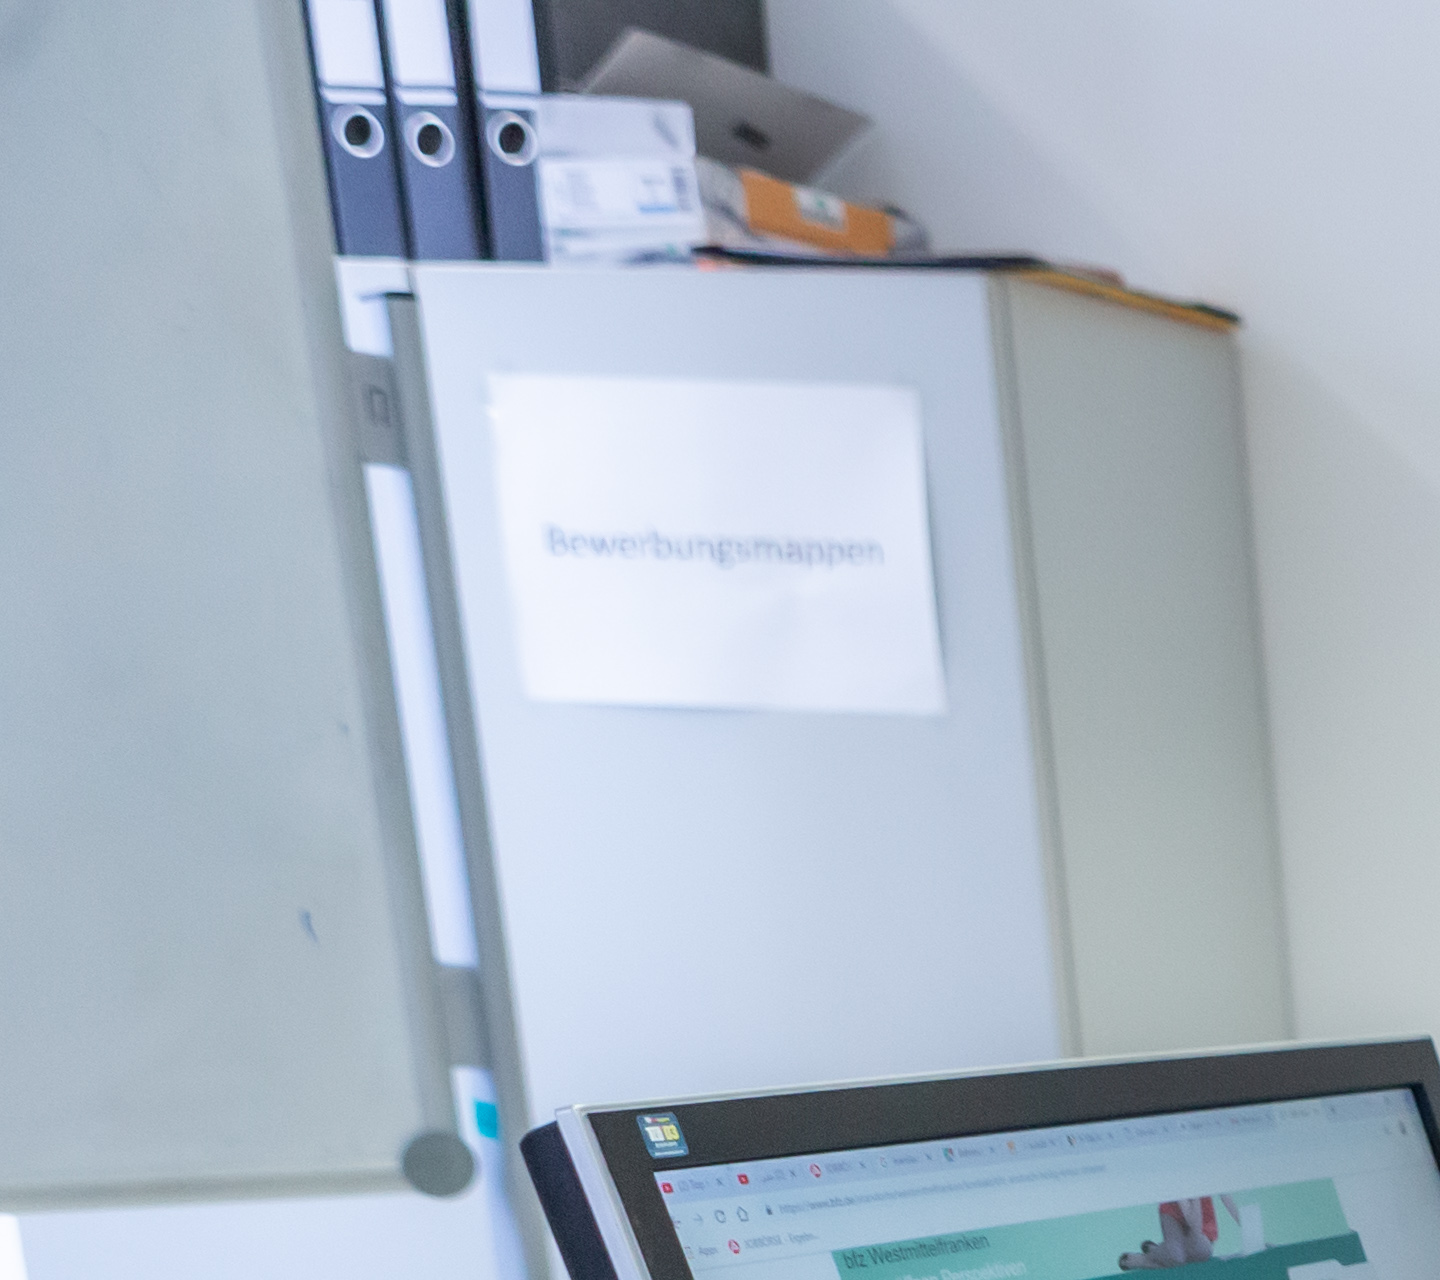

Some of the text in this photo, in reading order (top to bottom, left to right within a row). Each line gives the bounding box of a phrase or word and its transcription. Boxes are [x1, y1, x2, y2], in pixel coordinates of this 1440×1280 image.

[547, 526, 883, 573] Bewerbungsmappen
[843, 1235, 990, 1268] bfz Westmittelfranken
